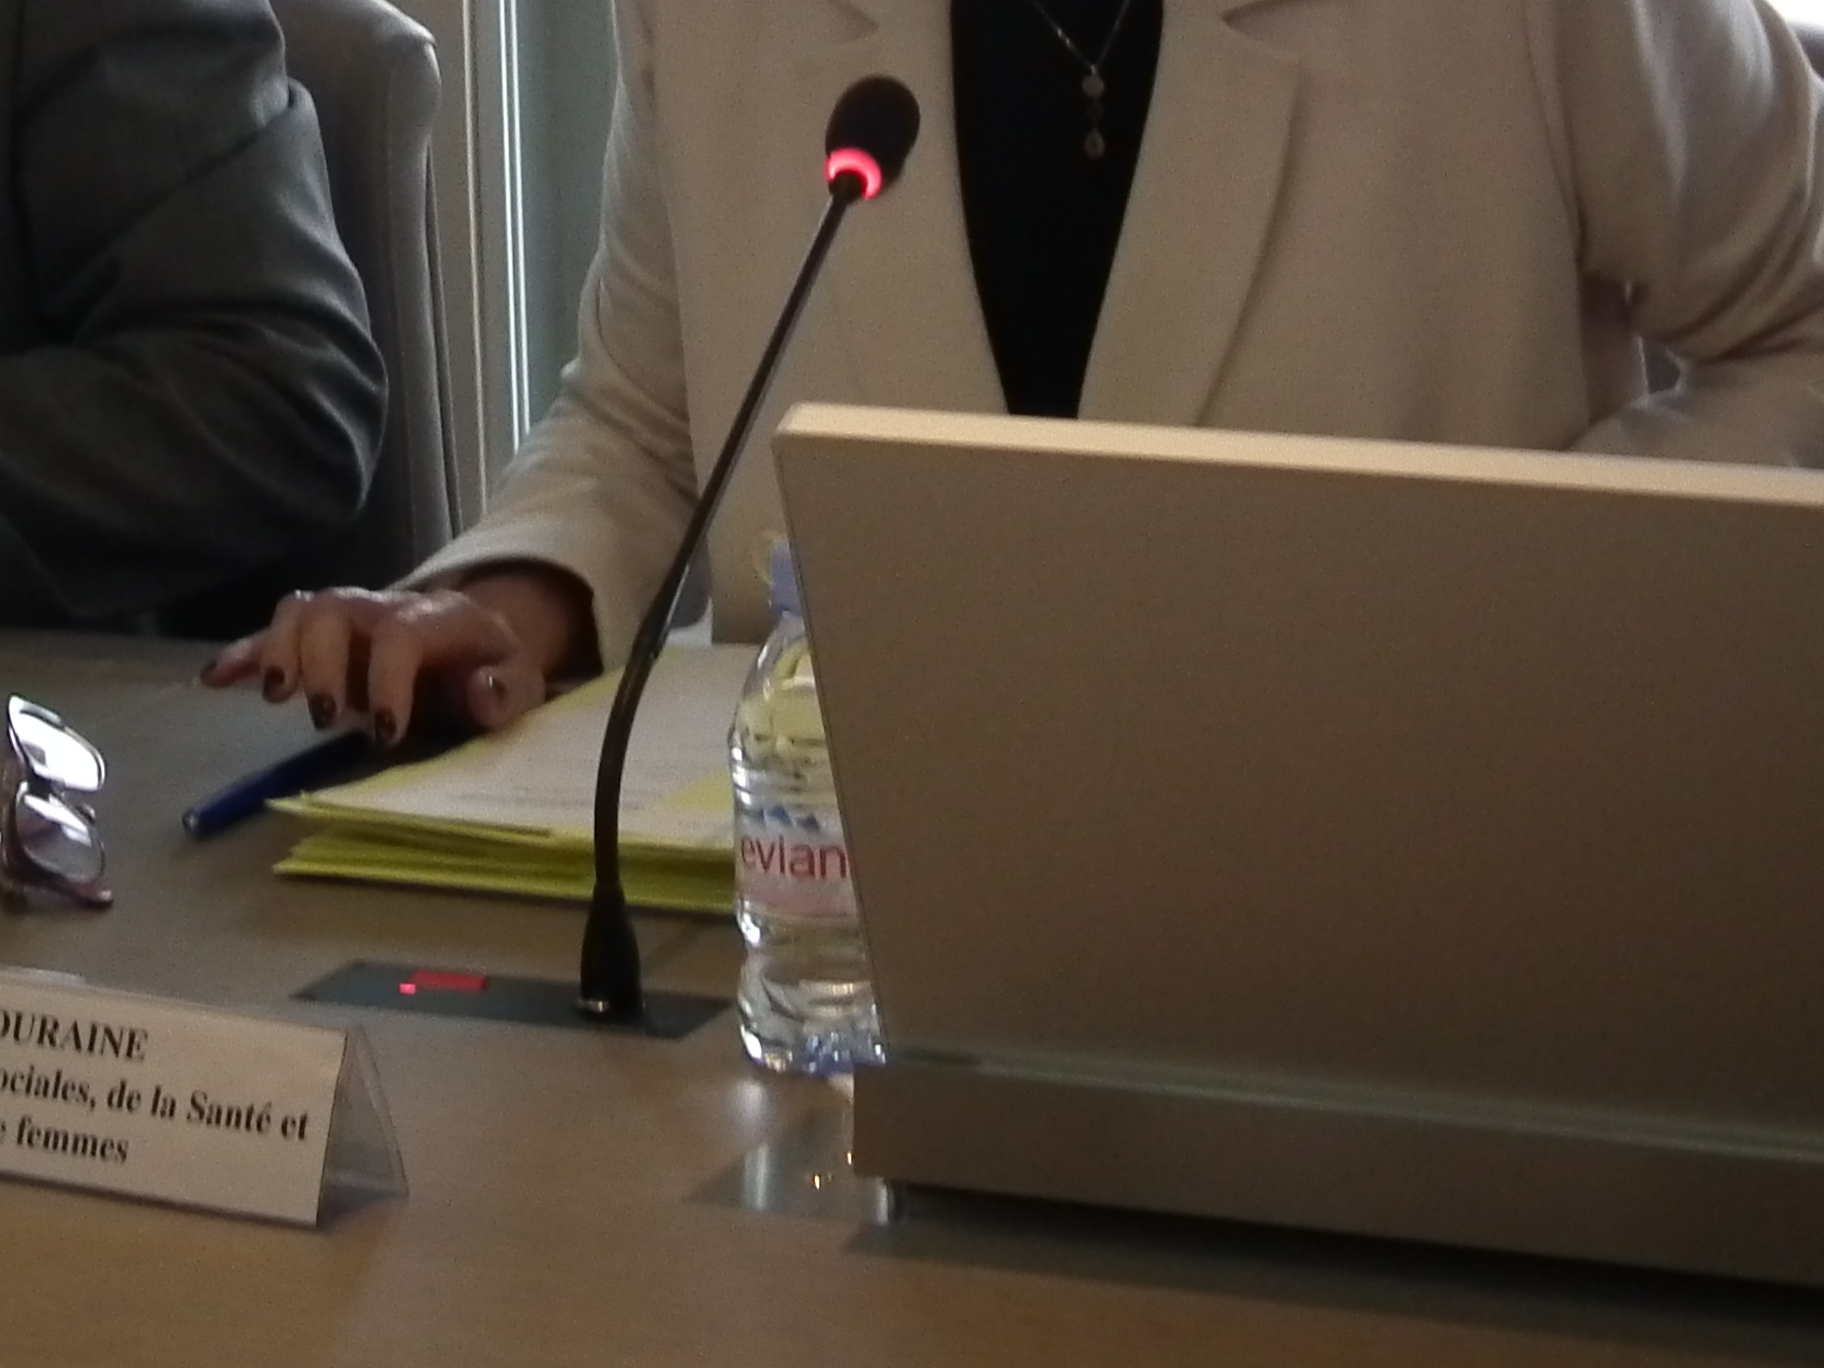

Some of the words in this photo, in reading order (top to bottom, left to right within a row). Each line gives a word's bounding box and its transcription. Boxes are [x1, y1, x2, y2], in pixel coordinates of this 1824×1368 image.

[740, 834, 847, 880] evian
[106, 1077, 142, 1113] de
[150, 1083, 177, 1120] la
[186, 1088, 272, 1134] Santé
[281, 1109, 309, 1142] et
[16, 1113, 129, 1164] femmes
